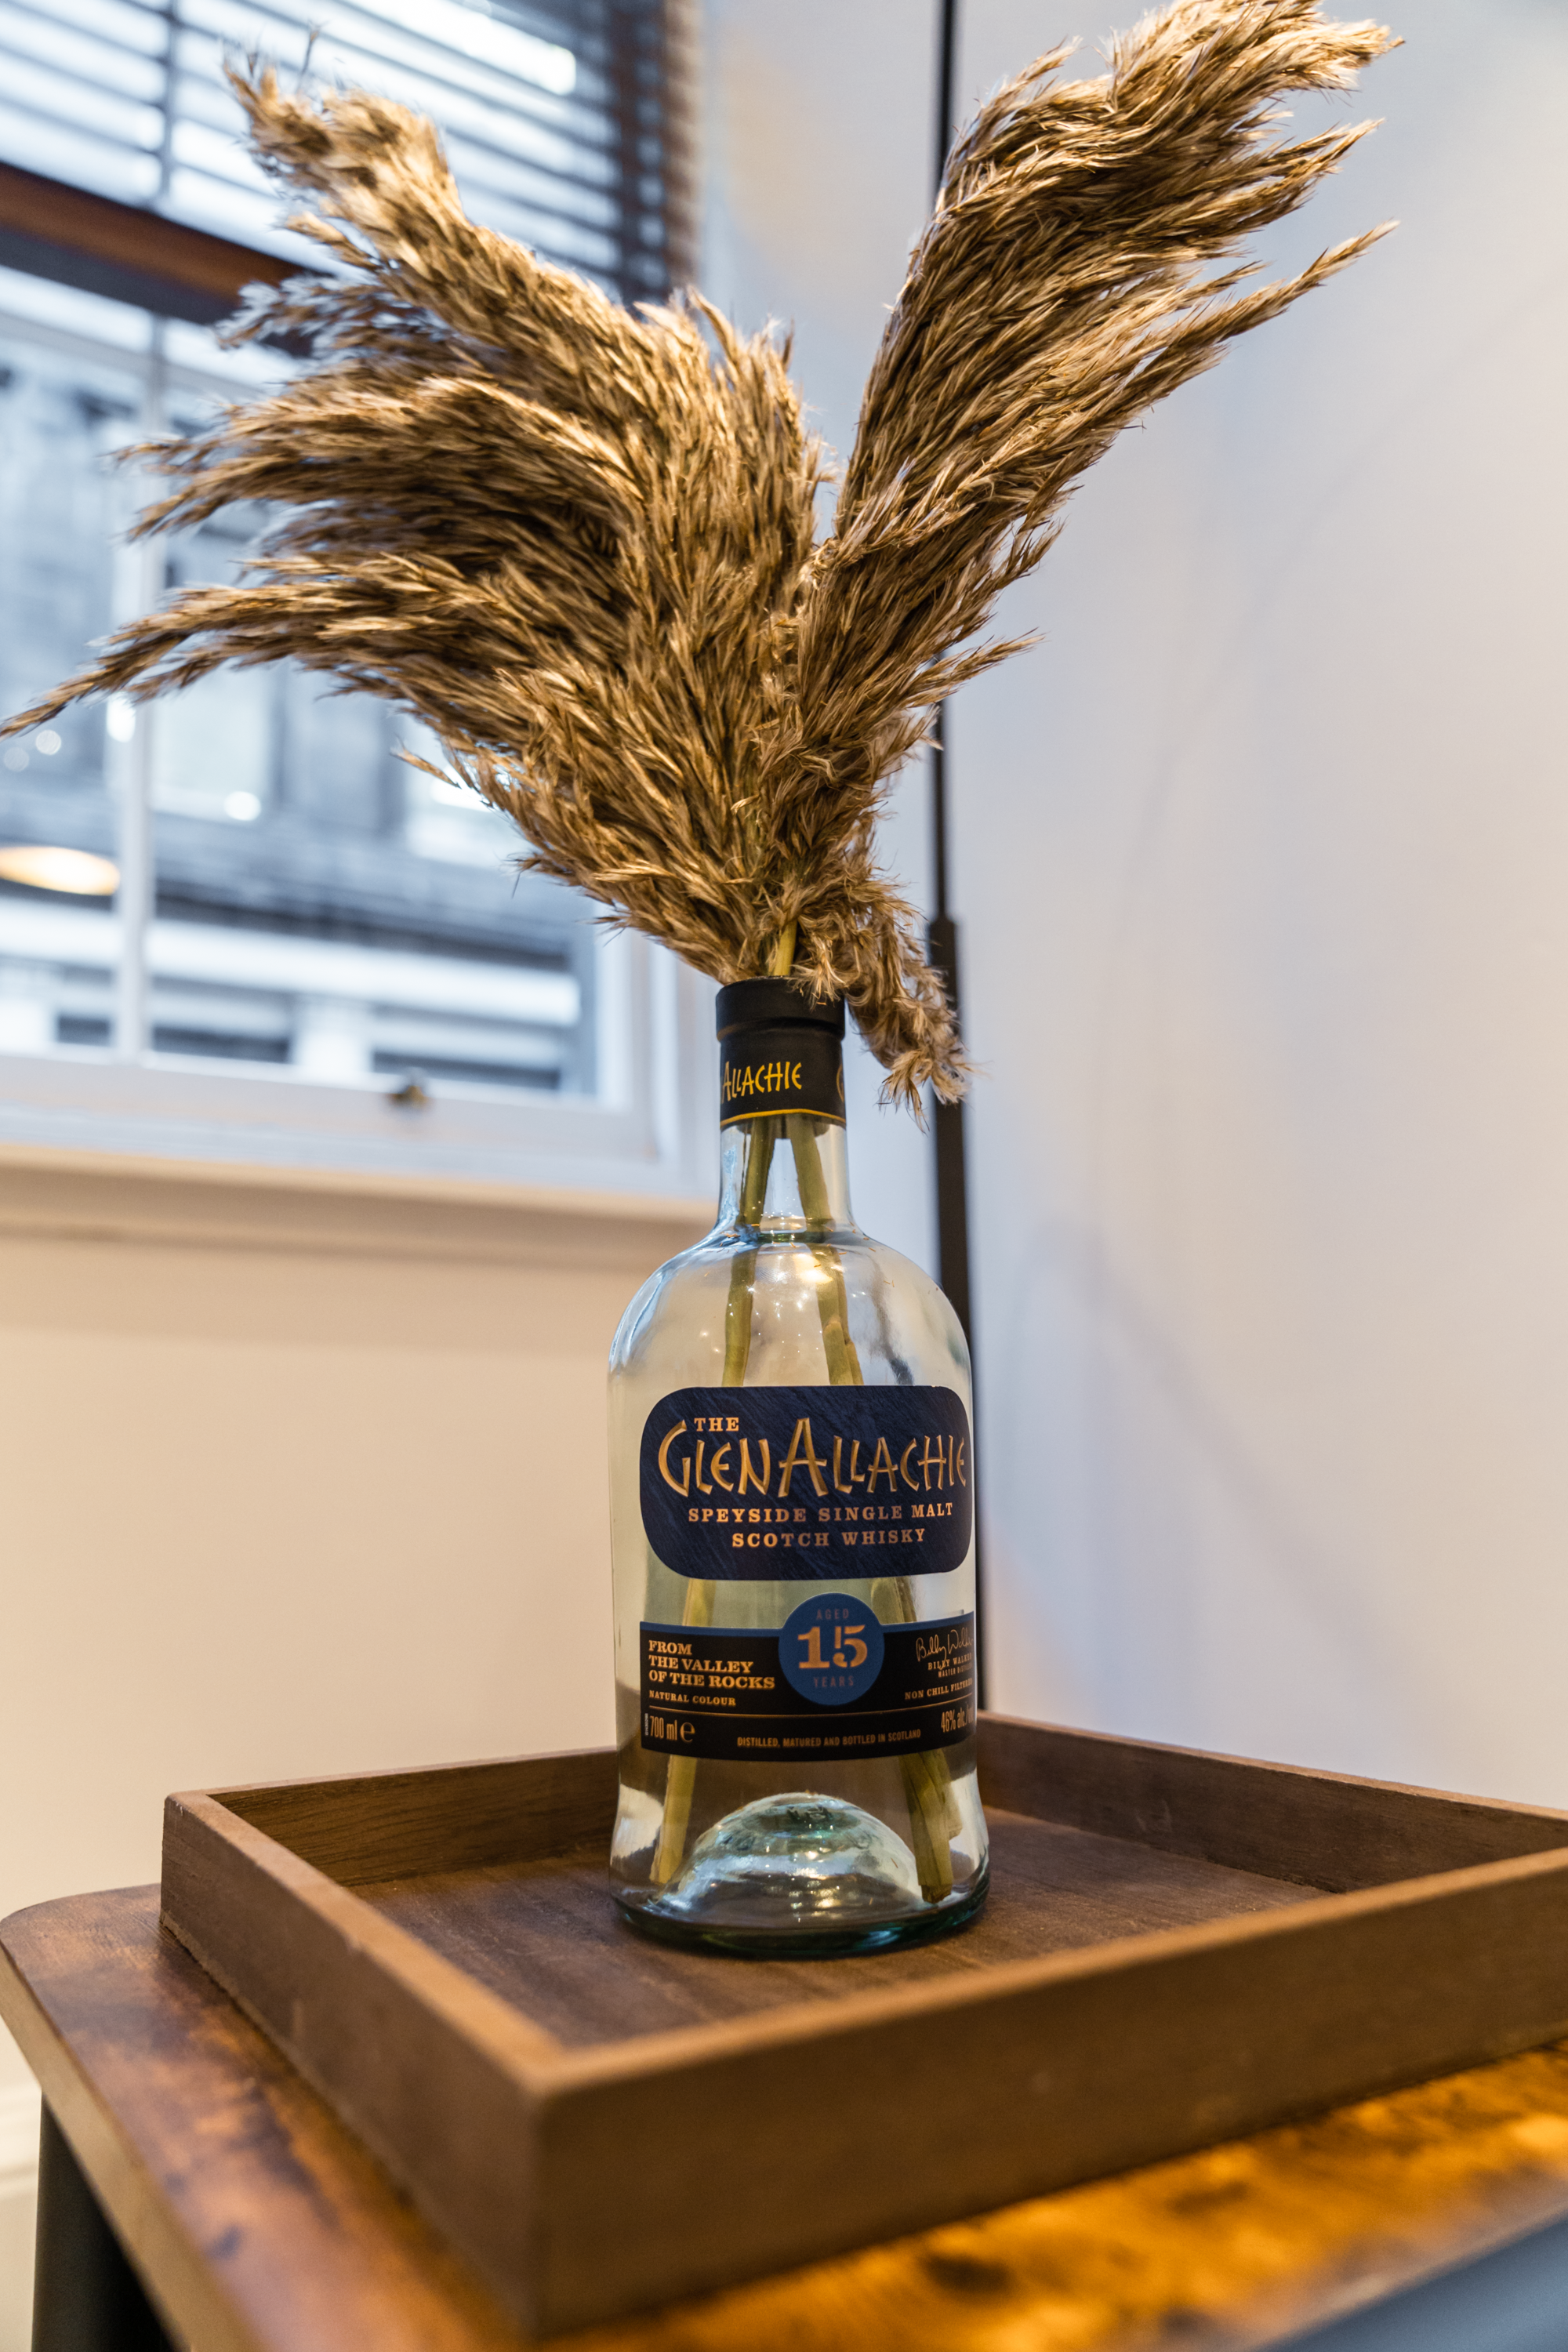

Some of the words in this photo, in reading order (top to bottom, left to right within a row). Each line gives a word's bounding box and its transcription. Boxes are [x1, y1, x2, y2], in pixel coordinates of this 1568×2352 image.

[694, 1417, 739, 1432] THE
[688, 1508, 806, 1522] SPEYSIDE
[818, 1505, 902, 1521] SINGLE
[911, 1502, 953, 1518] MALT
[732, 1533, 829, 1548] SCOTCH
[842, 1529, 925, 1545] WHISKY
[816, 1608, 849, 1620] AGED
[648, 1640, 692, 1655] FROM
[797, 1624, 868, 1668] 15
[648, 1655, 679, 1669] THE
[681, 1658, 753, 1673] VALLEY
[648, 1670, 667, 1682] OF
[670, 1672, 705, 1686] THE
[709, 1675, 775, 1689] ROCKS
[814, 1675, 854, 1687] YEARS
[649, 1690, 689, 1703] NATURAL
[692, 1696, 736, 1706] COLOUR
[905, 1690, 924, 1700] NON
[927, 1686, 949, 1697] CHILL
[650, 1715, 664, 1739] 700
[666, 1719, 677, 1740] ml
[941, 1709, 956, 1733] 46%
[783, 1737, 822, 1748] MATURED
[824, 1737, 840, 1746] AND
[842, 1734, 876, 1745] BOTTLED
[877, 1733, 886, 1742] IN
[887, 1729, 921, 1742] SCOTLAND
